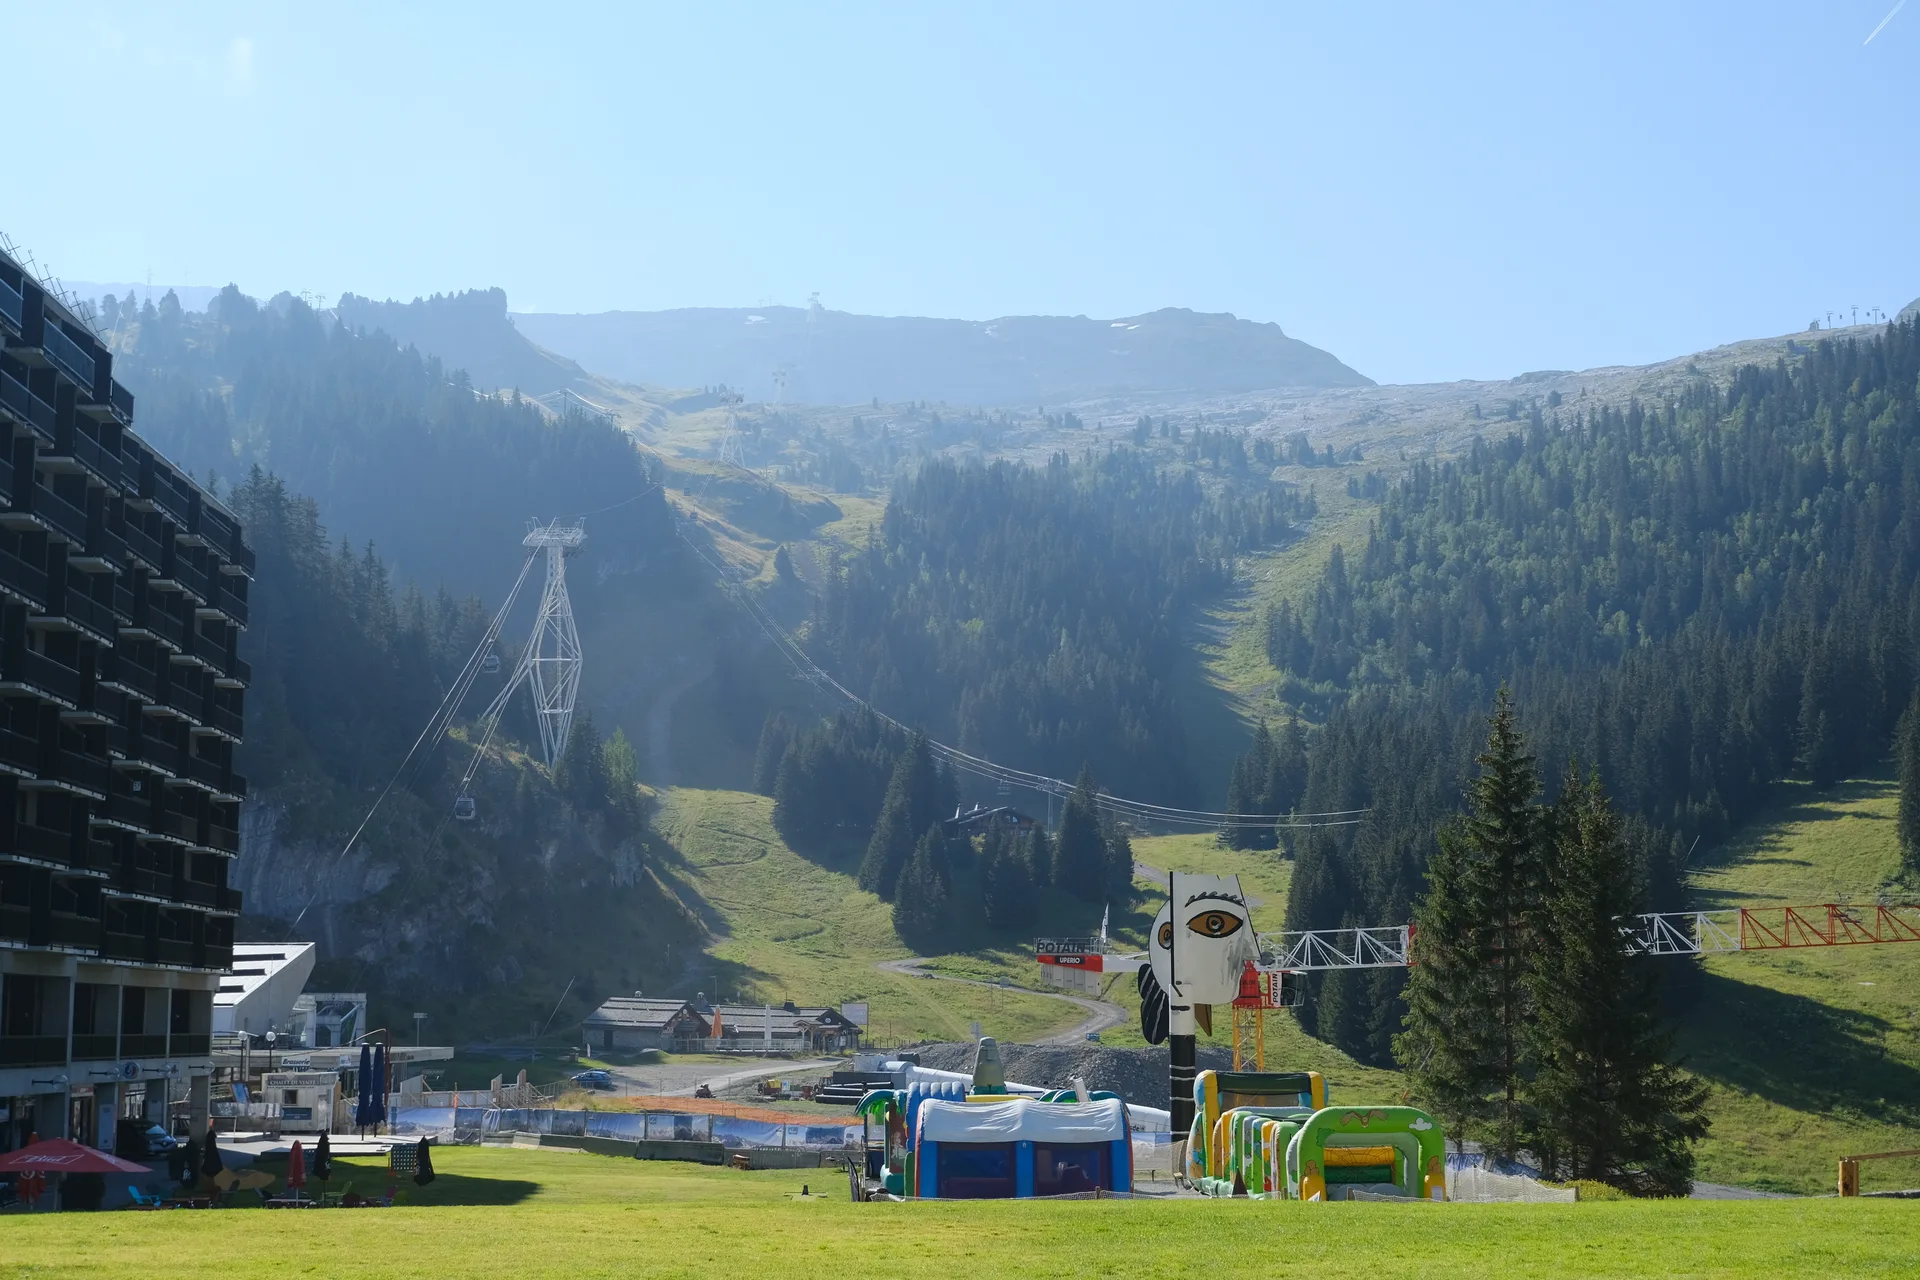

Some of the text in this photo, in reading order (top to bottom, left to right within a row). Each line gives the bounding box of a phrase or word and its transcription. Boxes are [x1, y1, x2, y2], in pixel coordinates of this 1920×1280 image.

[1036, 942, 1086, 953] POTAIN
[1059, 956, 1080, 964] UPERIO
[282, 1058, 311, 1066] Brasserie
